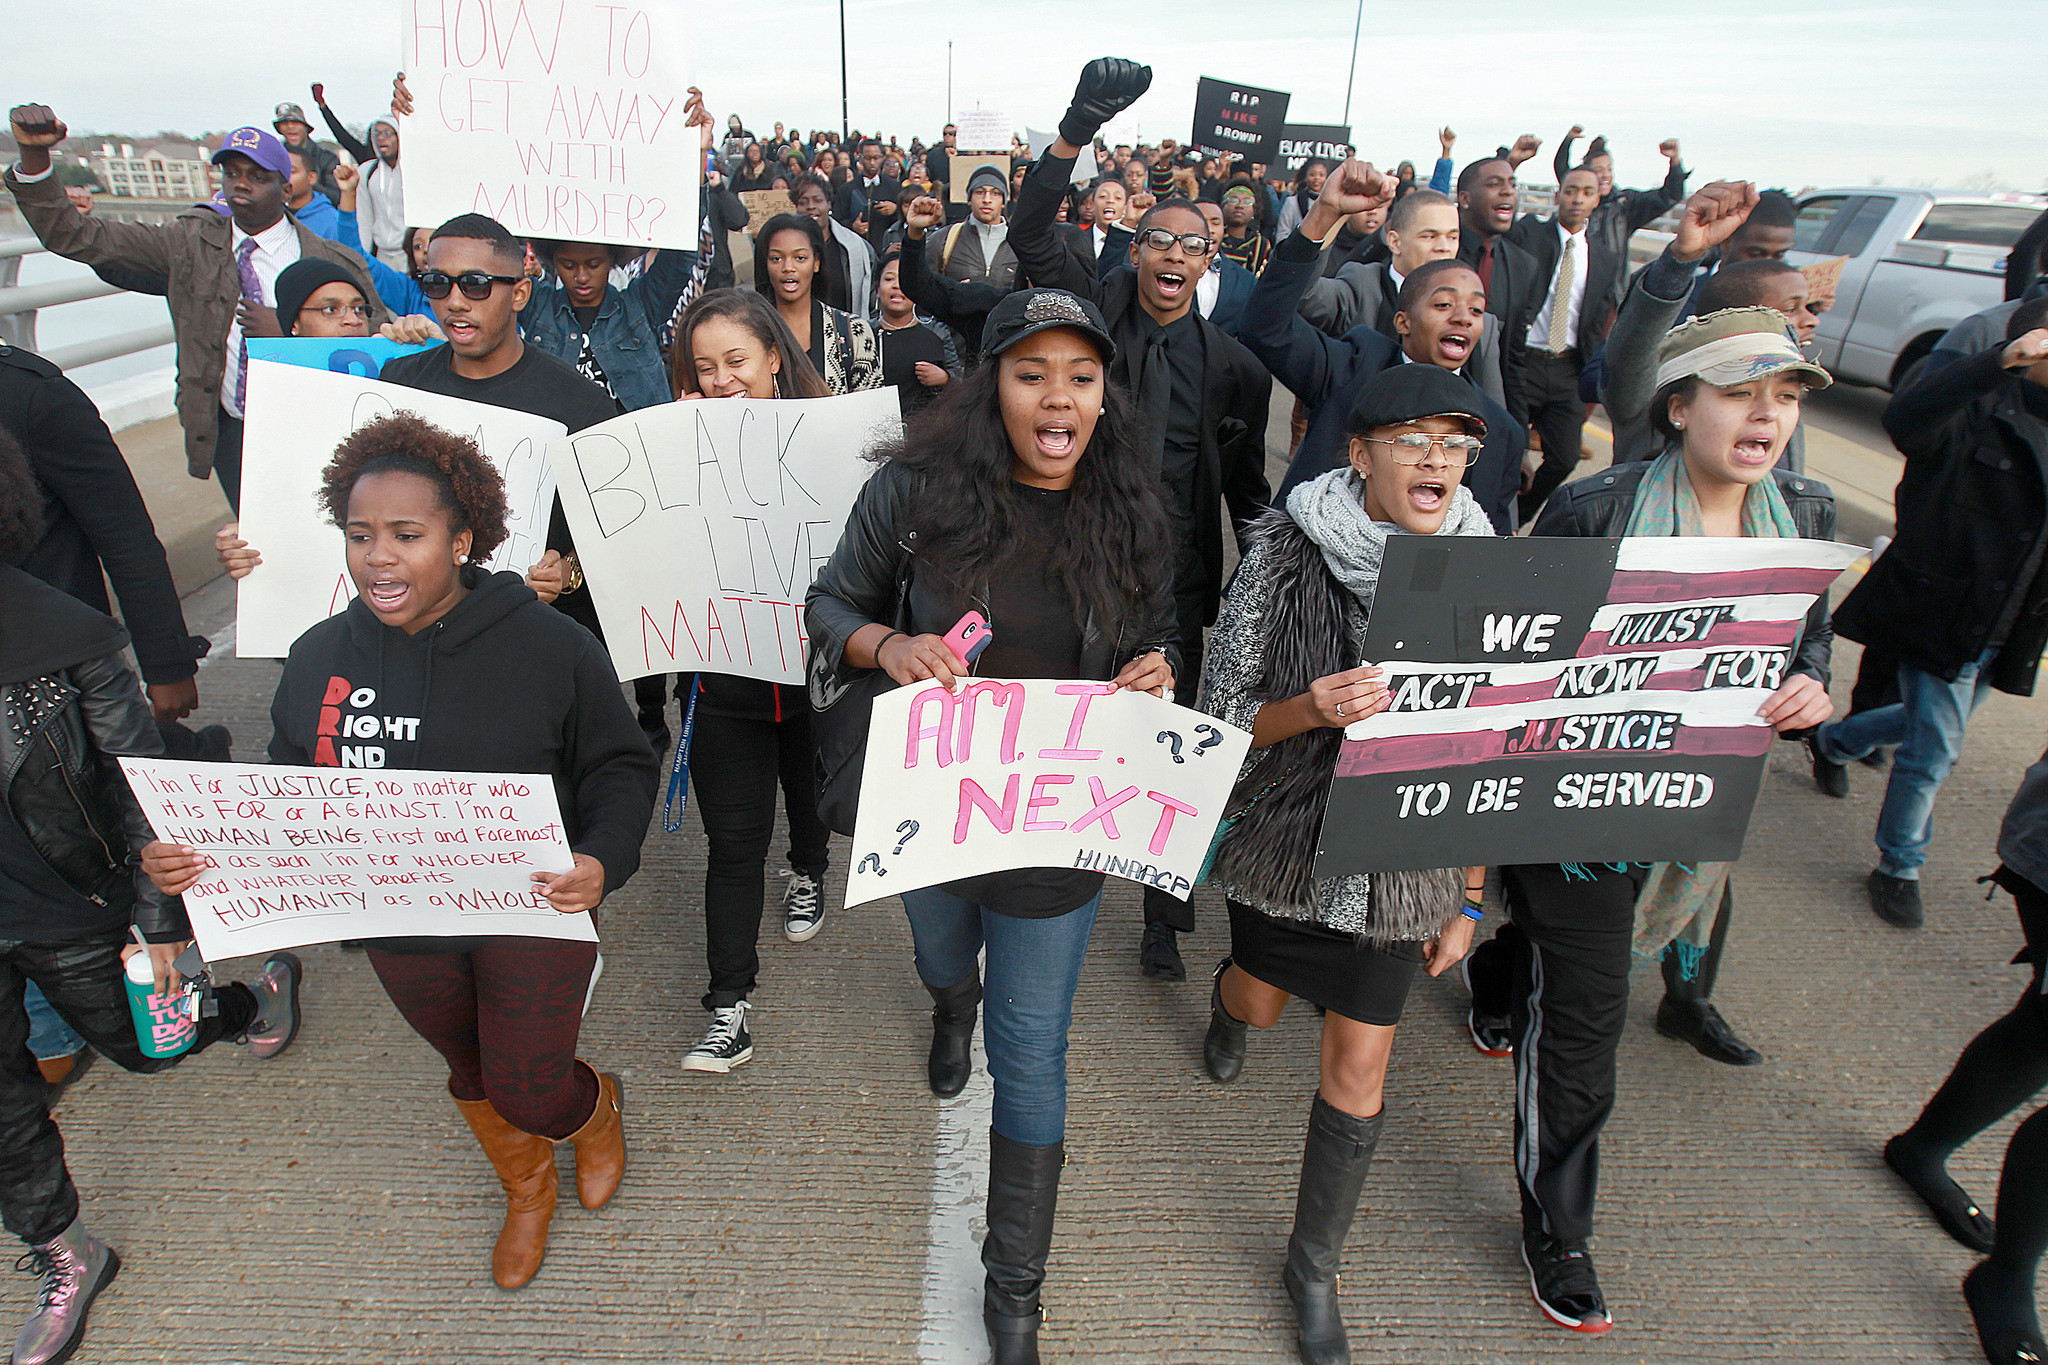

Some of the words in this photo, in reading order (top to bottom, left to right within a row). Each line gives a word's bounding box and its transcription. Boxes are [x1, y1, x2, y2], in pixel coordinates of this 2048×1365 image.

[414, 0, 565, 75] HOW
[595, 4, 651, 79] TO
[439, 72, 524, 135] GET
[545, 84, 675, 145] AWAY
[1221, 108, 1258, 124] MIKE
[1214, 124, 1262, 143] BROWN!
[1279, 139, 1314, 157] BLACK
[515, 139, 626, 185] WITH
[472, 181, 667, 242] MURDER?
[571, 407, 822, 539] BLACK
[1482, 612, 1562, 654] WE
[1608, 606, 1731, 647] MUST
[322, 675, 377, 709] DO
[1389, 672, 1487, 713] ACT
[1553, 659, 1659, 699] NOW
[1703, 650, 1787, 690] FOR
[316, 706, 421, 741] RIGHT
[674, 738, 688, 773] HAMPTON
[682, 694, 698, 737] UNIVERSITY
[1508, 713, 1679, 752] JUSTICE
[314, 736, 386, 768] AND
[237, 774, 370, 799] JUSTICE,
[374, 780, 403, 796] no
[413, 778, 478, 797] matter
[488, 779, 530, 798] who
[1396, 780, 1452, 819] TO
[1467, 776, 1524, 815] BE
[1553, 771, 1715, 810] SERVED
[212, 800, 276, 821] FOR
[286, 807, 307, 820] or
[499, 805, 519, 822] a
[953, 773, 1199, 857] NEXT
[164, 825, 271, 846] HUMAN
[434, 828, 469, 845] and
[228, 855, 261, 869] as
[267, 854, 311, 869] such
[413, 851, 533, 868] WHOEVER
[1073, 848, 1191, 892] HUNAACP
[192, 879, 230, 898] and
[234, 873, 358, 891] WHATEVER
[212, 891, 366, 927] HUMANITY
[384, 893, 412, 906] as
[429, 895, 444, 906] a
